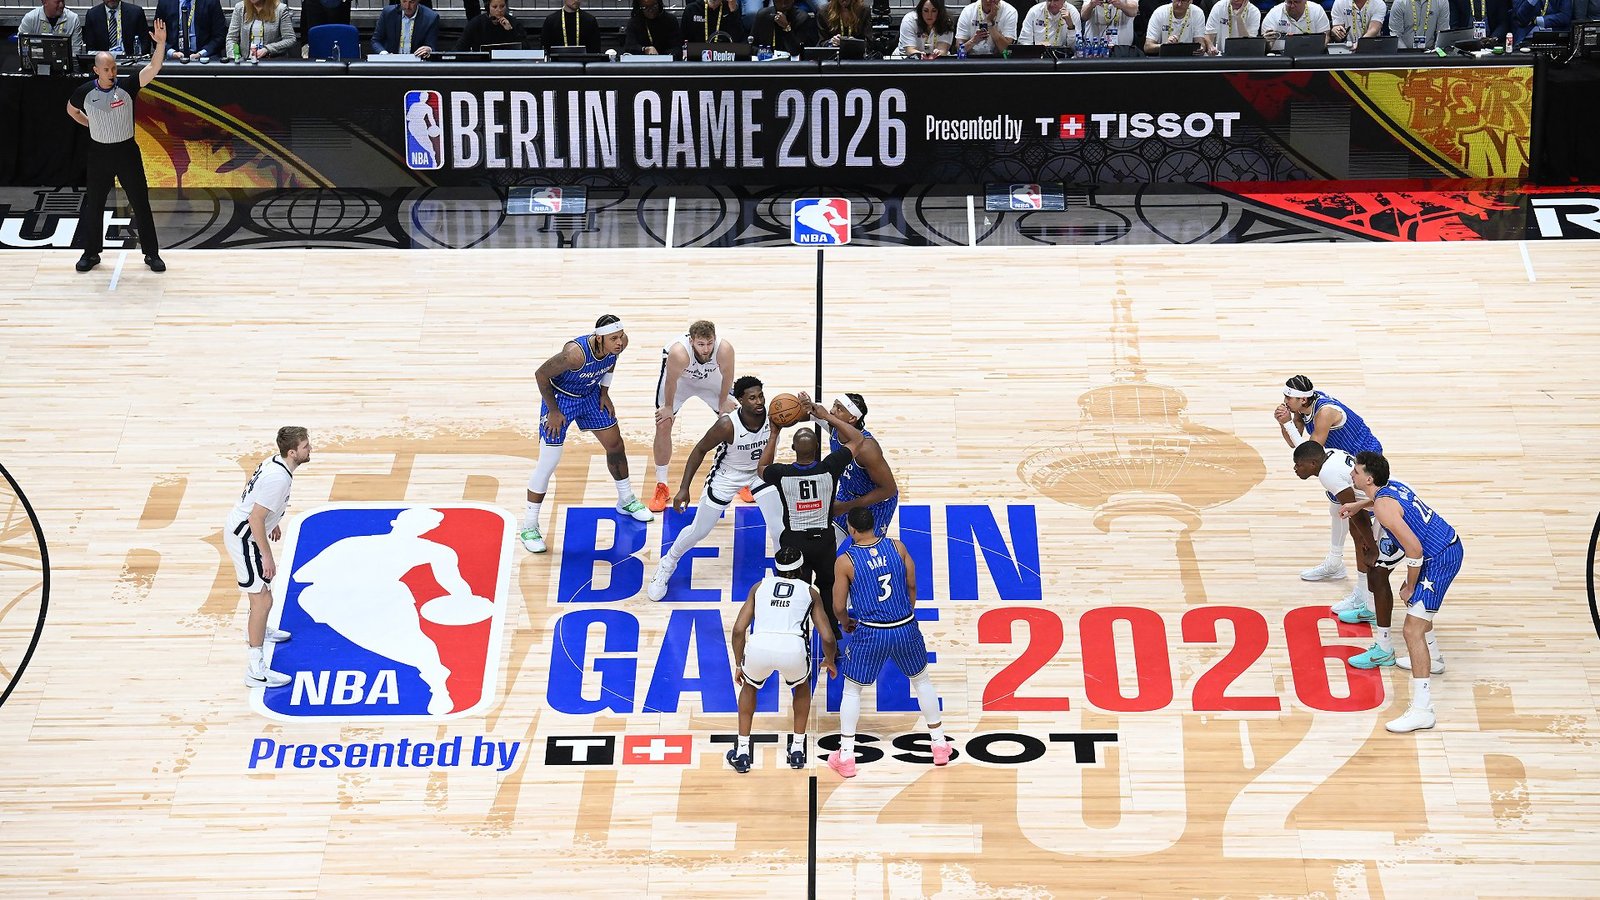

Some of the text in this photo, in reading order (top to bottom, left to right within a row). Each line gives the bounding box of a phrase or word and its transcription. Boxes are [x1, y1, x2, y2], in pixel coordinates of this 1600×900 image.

[713, 50, 735, 61] Replay
[450, 88, 907, 169] BERLIN GAME 2026
[925, 114, 1023, 144] Presented by
[1091, 112, 1241, 139] TISSOT
[411, 152, 429, 165] NBA
[800, 233, 828, 243] NBA
[737, 439, 769, 451] MEMPH
[750, 448, 764, 461] 8
[799, 480, 818, 499] 61
[867, 556, 888, 570] BANE
[773, 581, 795, 599] 0
[877, 573, 893, 602] 3
[770, 599, 791, 608] WELLS
[977, 606, 1385, 712] 2026
[289, 670, 400, 706] NBA
[248, 736, 521, 771] Presented by
